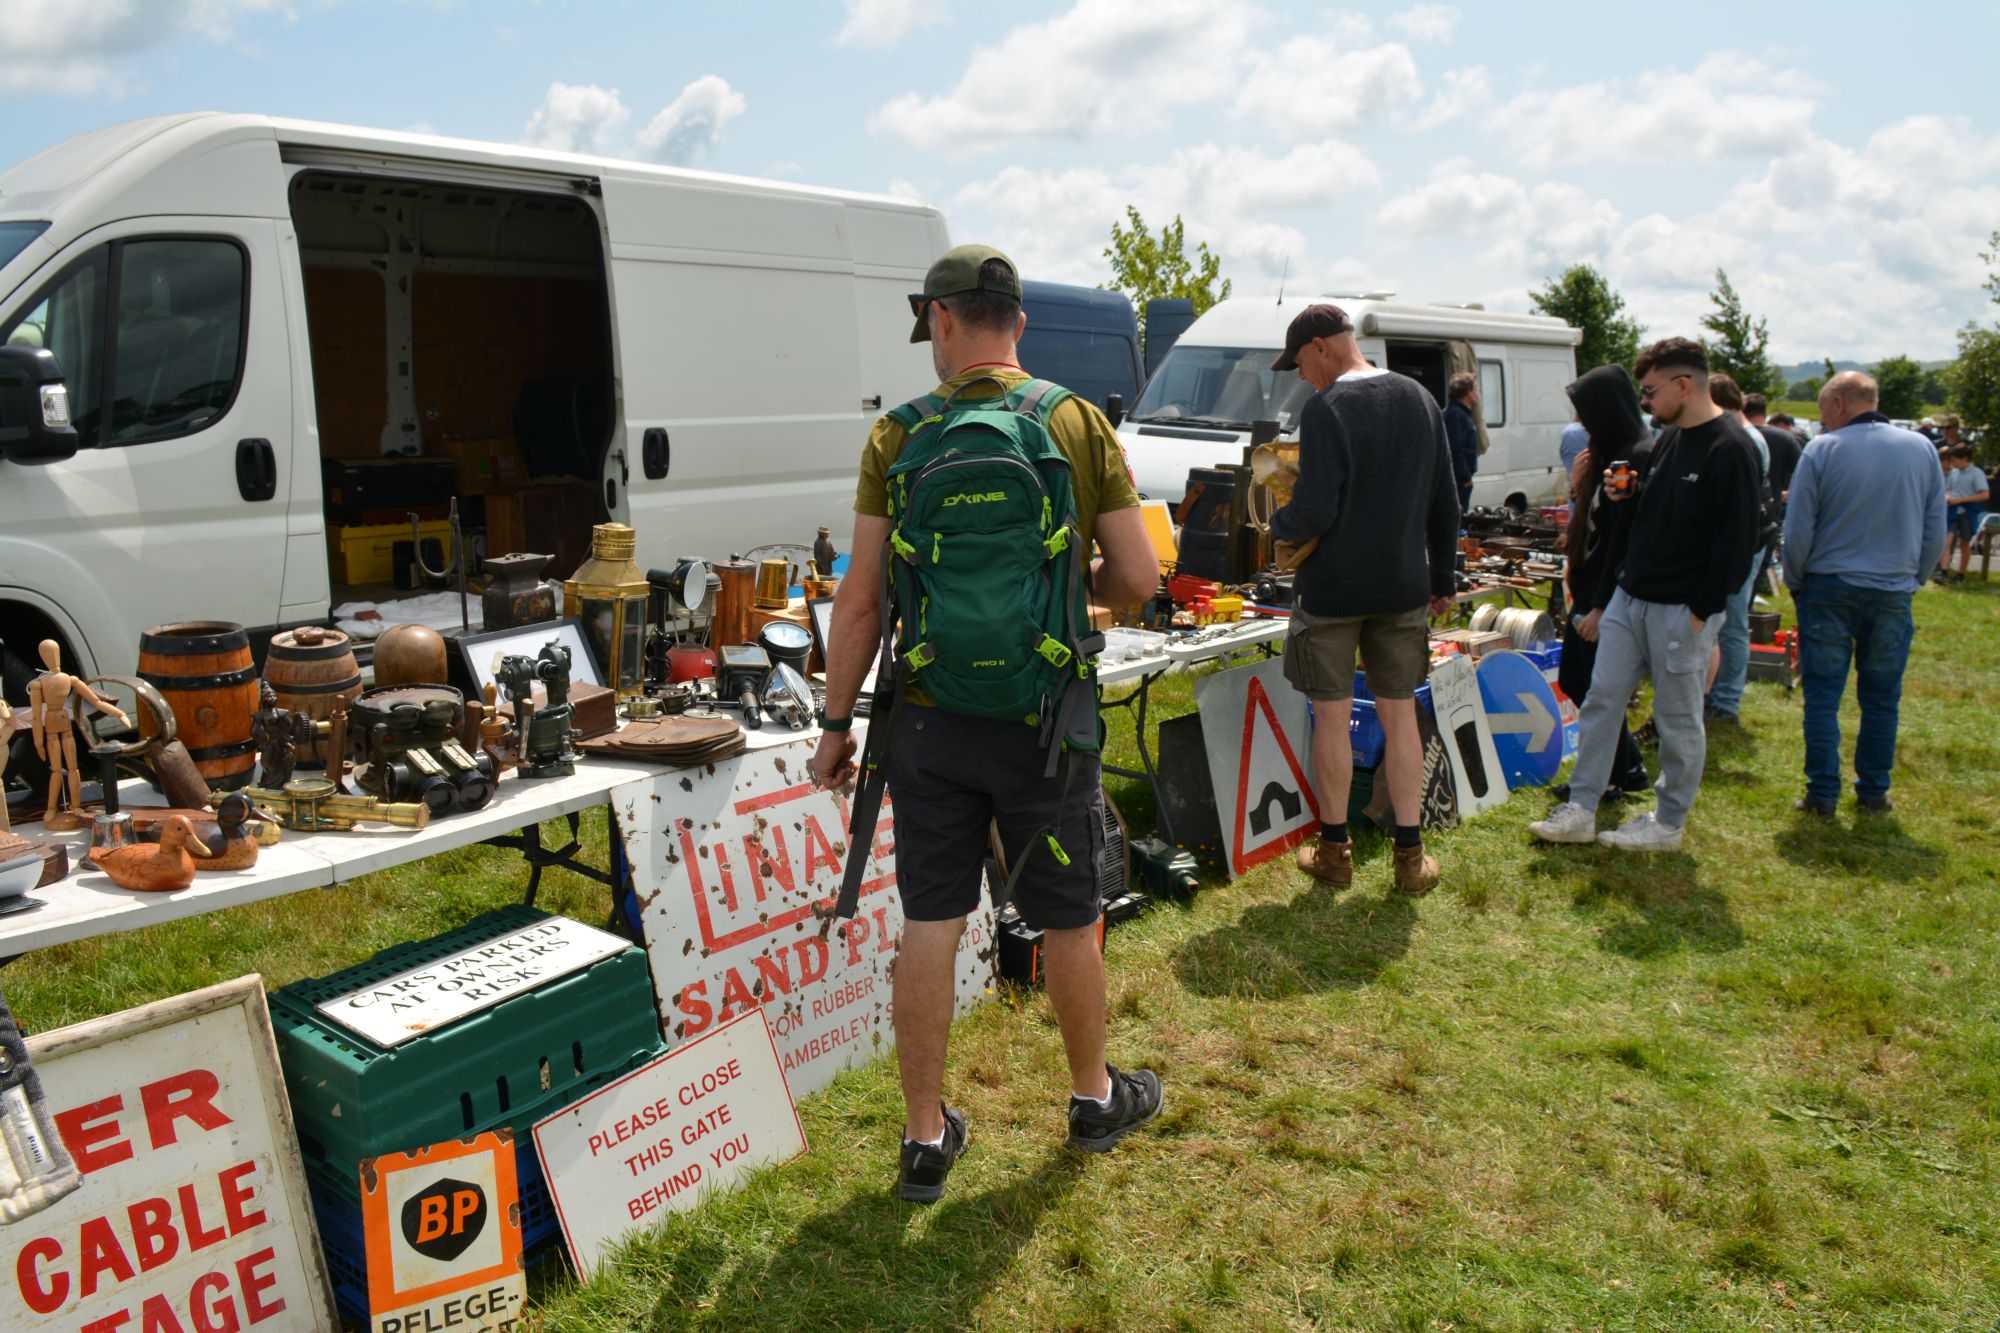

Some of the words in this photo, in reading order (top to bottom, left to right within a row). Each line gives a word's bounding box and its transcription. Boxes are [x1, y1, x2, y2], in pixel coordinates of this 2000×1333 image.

[972, 660, 997, 668] PRO
[348, 971, 438, 1009] CARS
[443, 924, 562, 973] PARKED
[390, 991, 431, 1014] AT
[437, 937, 570, 993] OWNERS
[673, 934, 830, 1039] SAND
[812, 975, 875, 1020] RUBBER
[588, 1097, 672, 1157] PLEASE
[678, 1058, 742, 1106] CLOSE
[624, 1137, 674, 1177] THIS
[680, 1103, 732, 1146] GATE
[415, 1189, 479, 1245] BP
[627, 1163, 702, 1221] BEHIND
[709, 1133, 750, 1169] YOU
[16, 1159, 268, 1314] CABLE
